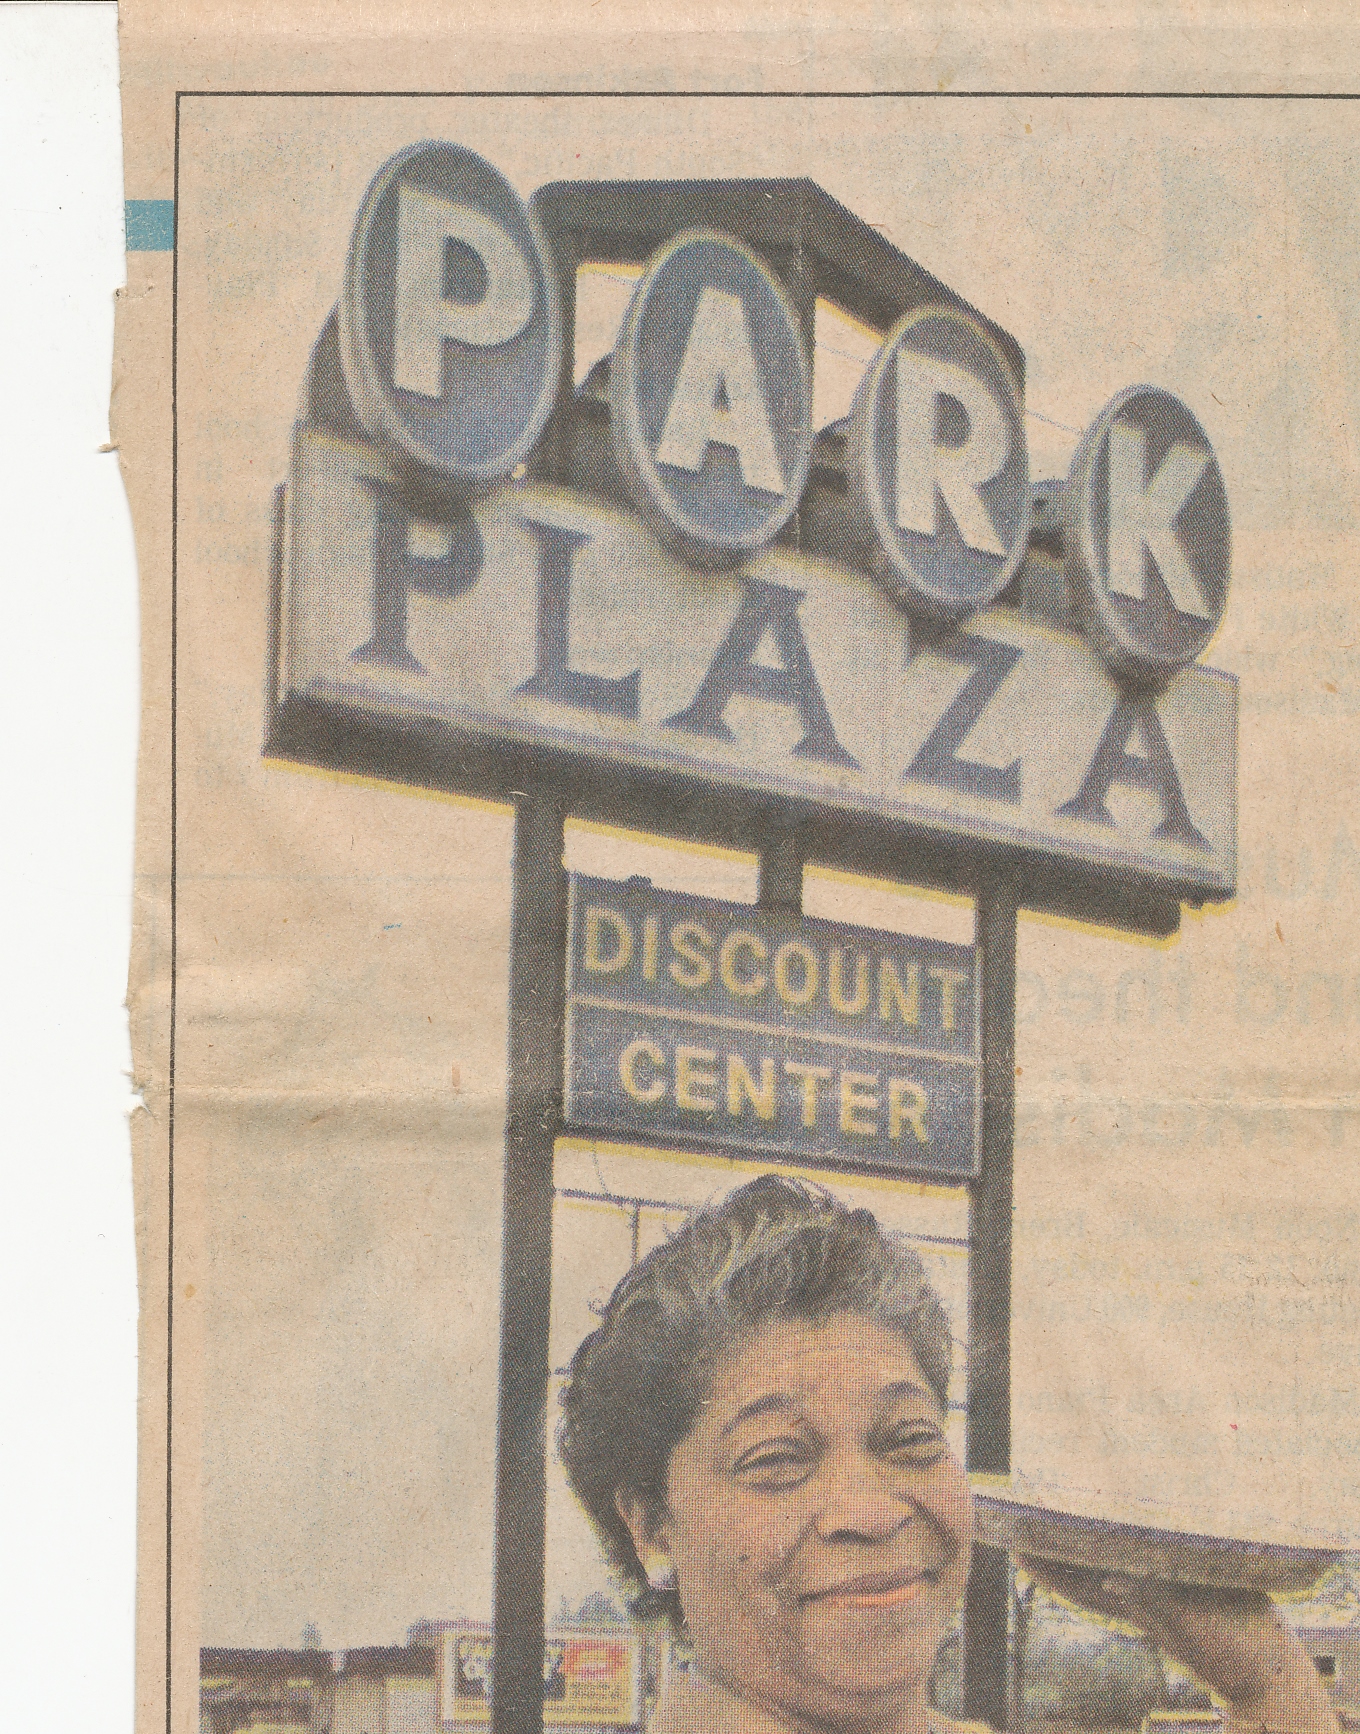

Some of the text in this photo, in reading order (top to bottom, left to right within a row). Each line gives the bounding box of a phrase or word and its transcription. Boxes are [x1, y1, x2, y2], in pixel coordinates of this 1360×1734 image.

[394, 181, 1211, 621] PARK
[345, 472, 1213, 853] PLAZA
[583, 905, 970, 1030] DISCOUNT
[619, 1038, 929, 1144] CENTER
